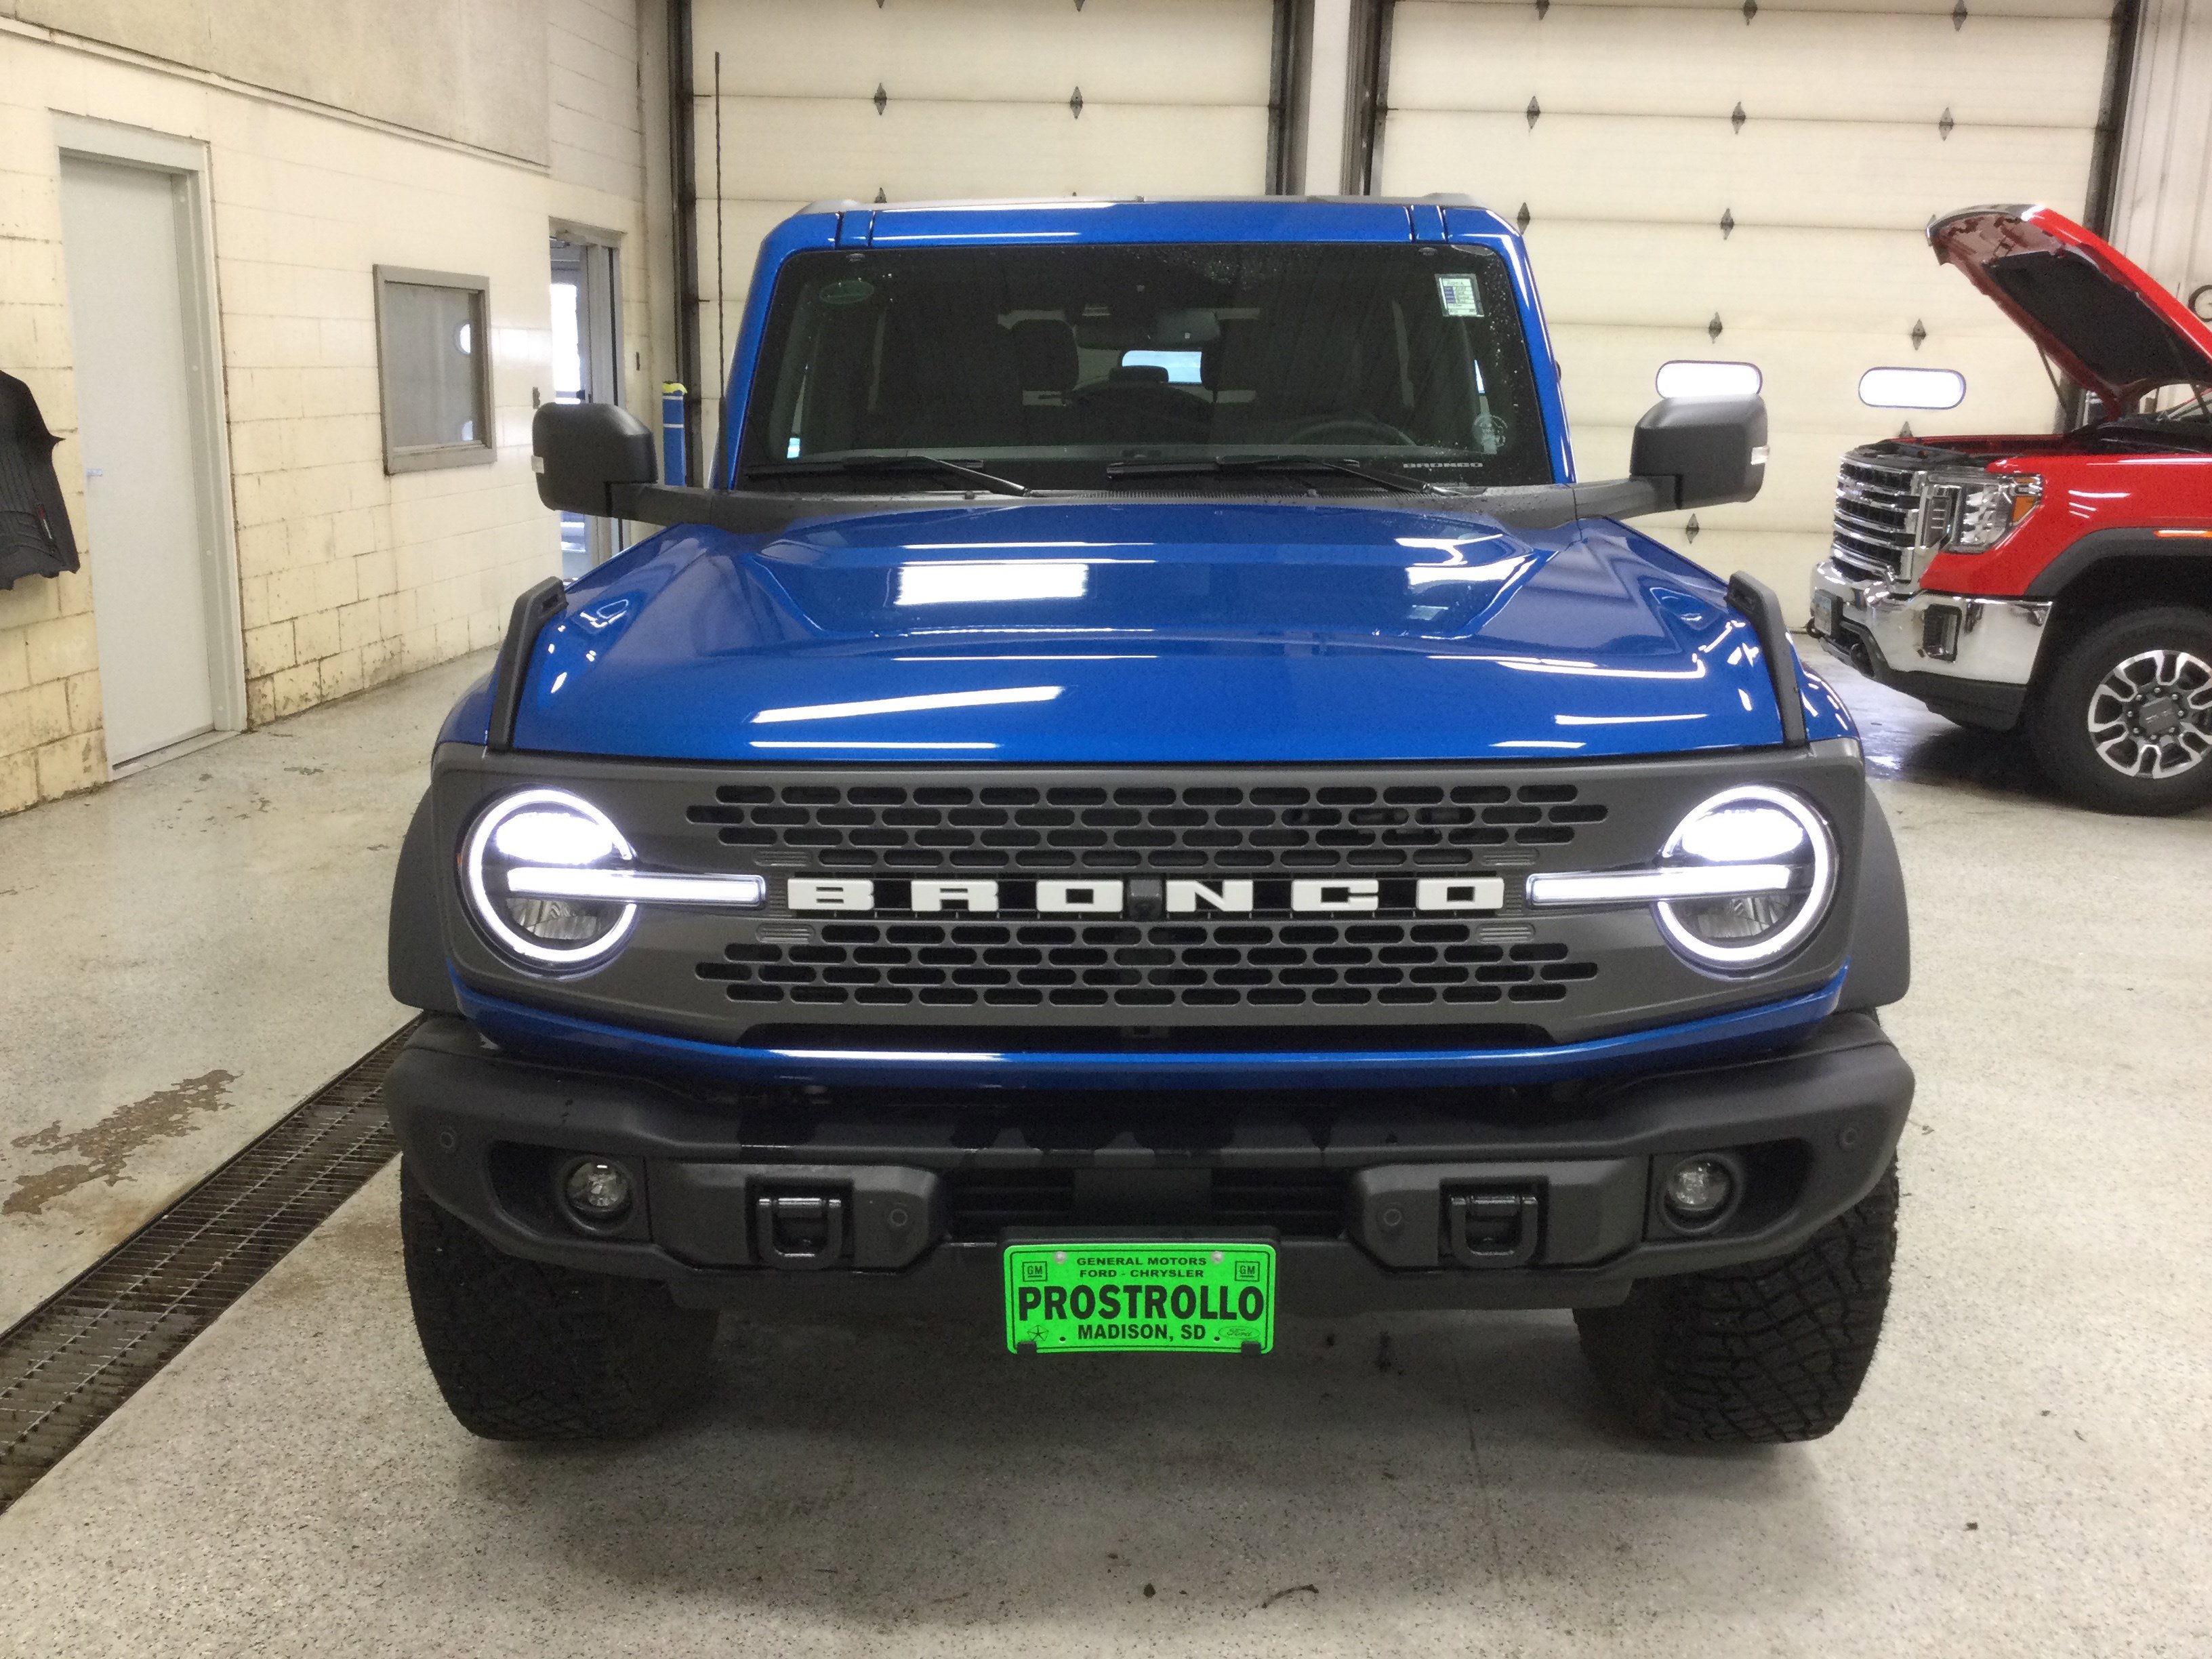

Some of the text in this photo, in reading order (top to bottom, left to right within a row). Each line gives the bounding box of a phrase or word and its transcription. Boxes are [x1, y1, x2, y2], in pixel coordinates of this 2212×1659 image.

[787, 878, 1504, 913] BRONCO
[1076, 1257, 1207, 1266] GENERAL MOTORS
[1027, 1265, 1043, 1275] GM
[1080, 1269, 1117, 1278] FORD
[1130, 1269, 1204, 1278] CHRYSLER
[1239, 1265, 1255, 1275] GM
[1018, 1284, 1265, 1322] PROSTROLLO
[1078, 1324, 1206, 1342] MADISON, SD
[1226, 1328, 1252, 1336] Ford
